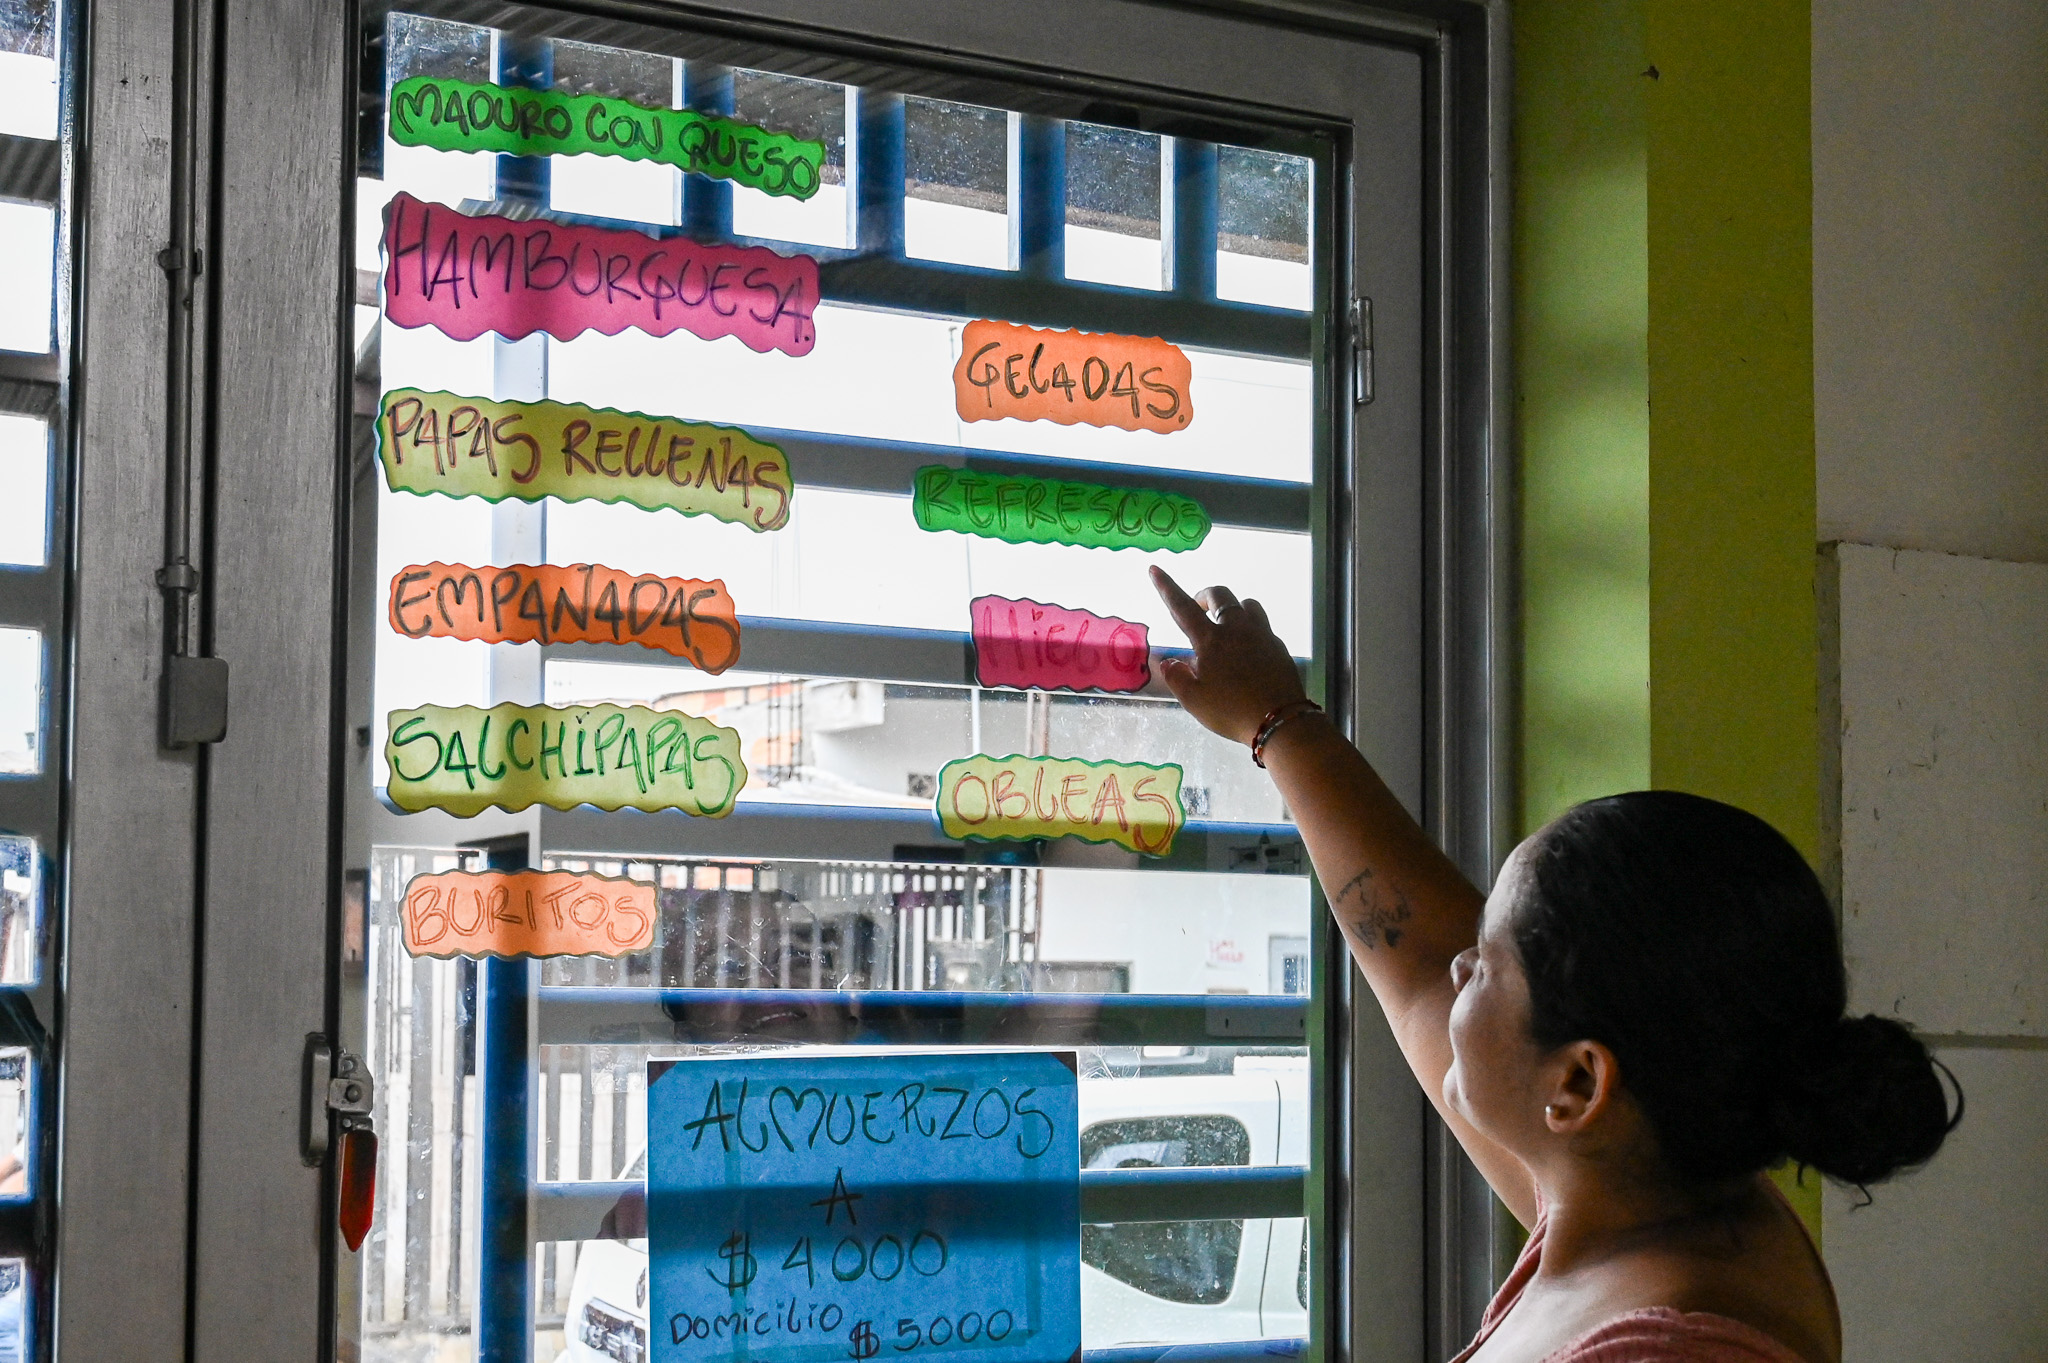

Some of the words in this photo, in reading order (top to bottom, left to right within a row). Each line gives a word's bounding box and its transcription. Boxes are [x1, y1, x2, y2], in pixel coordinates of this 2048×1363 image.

[396, 83, 572, 136] MADURO
[586, 103, 664, 152] CON
[679, 122, 818, 195] QUESO
[387, 397, 541, 484] PAPAS
[561, 419, 788, 530] RELLENAS
[919, 471, 1208, 543] REFRESCOS
[395, 565, 740, 672] EMPANADAS
[952, 765, 1176, 852] OBLEAS
[407, 881, 650, 947] BURITOS
[683, 1077, 1054, 1159] ALMUERZOS
[810, 1167, 863, 1226] A
